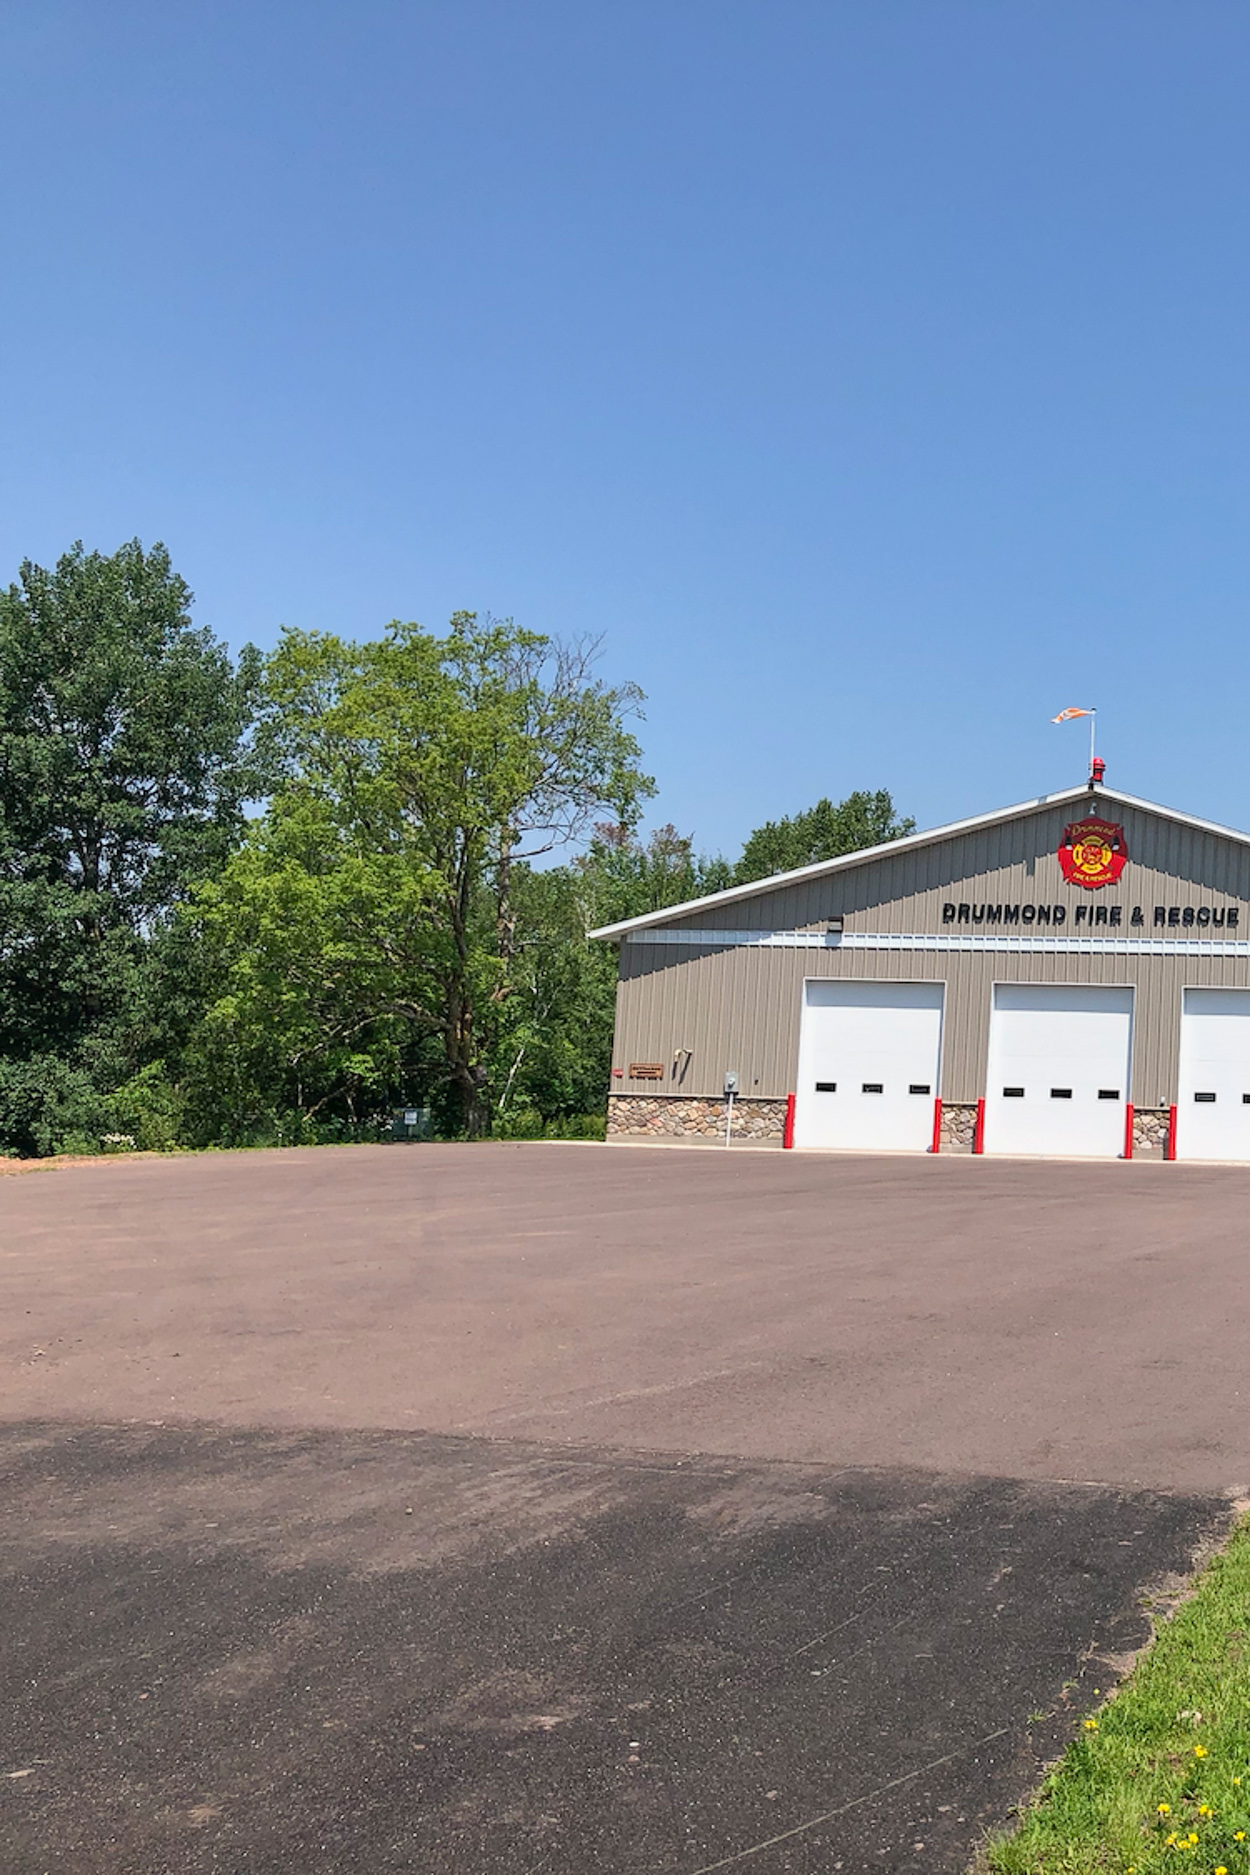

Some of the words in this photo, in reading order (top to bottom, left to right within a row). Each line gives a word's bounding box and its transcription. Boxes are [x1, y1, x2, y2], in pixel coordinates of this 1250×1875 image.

[942, 903, 1066, 925] DRUMMOND
[1075, 905, 1122, 926] FIRE
[1130, 906, 1144, 927] &
[1154, 906, 1239, 927] RESCUE
